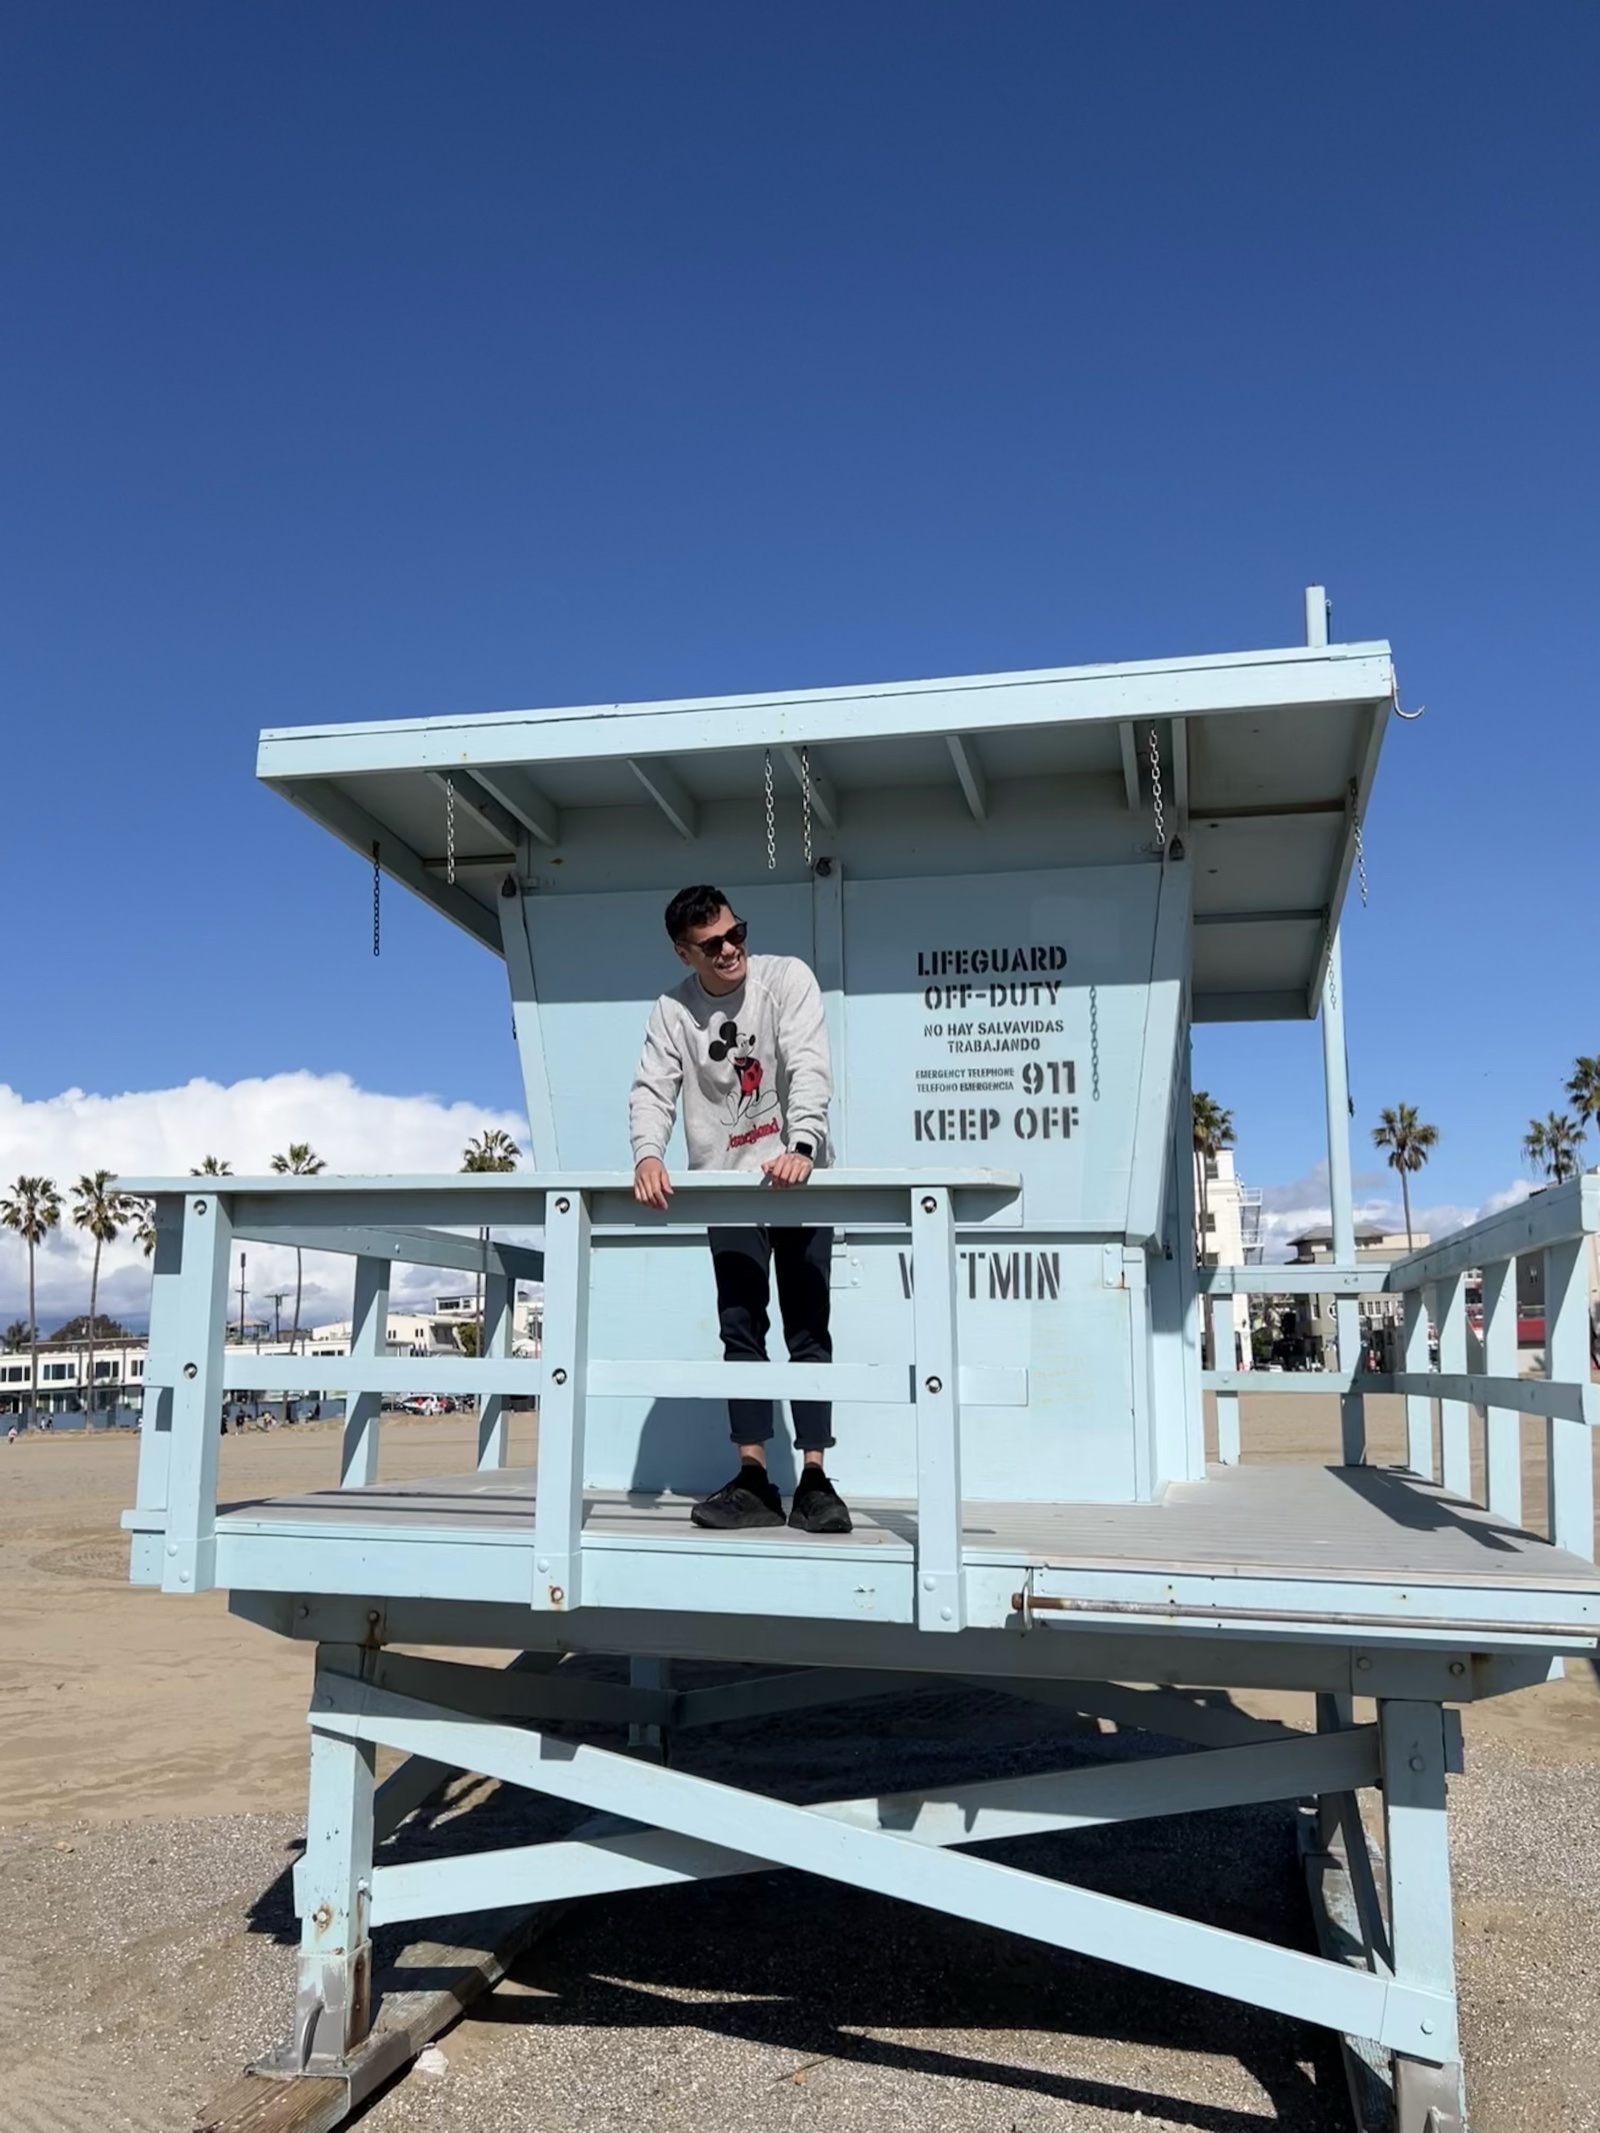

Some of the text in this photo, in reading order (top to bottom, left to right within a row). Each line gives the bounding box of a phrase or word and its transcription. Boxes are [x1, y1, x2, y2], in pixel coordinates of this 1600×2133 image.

[918, 946, 1067, 976] LIFEGUARD
[925, 980, 1062, 1010] OFF-DUTY
[924, 1020, 1064, 1037] NO HAY SALVAVIDAS
[947, 1038, 1040, 1053] TRABAJANDO
[915, 1067, 1015, 1079] EMERGENCY TELEPHONE
[1022, 1061, 1075, 1095] 911
[916, 1081, 1014, 1093] TELEFONO EMERGENCIA
[914, 1106, 1079, 1141] KEEP OFF
